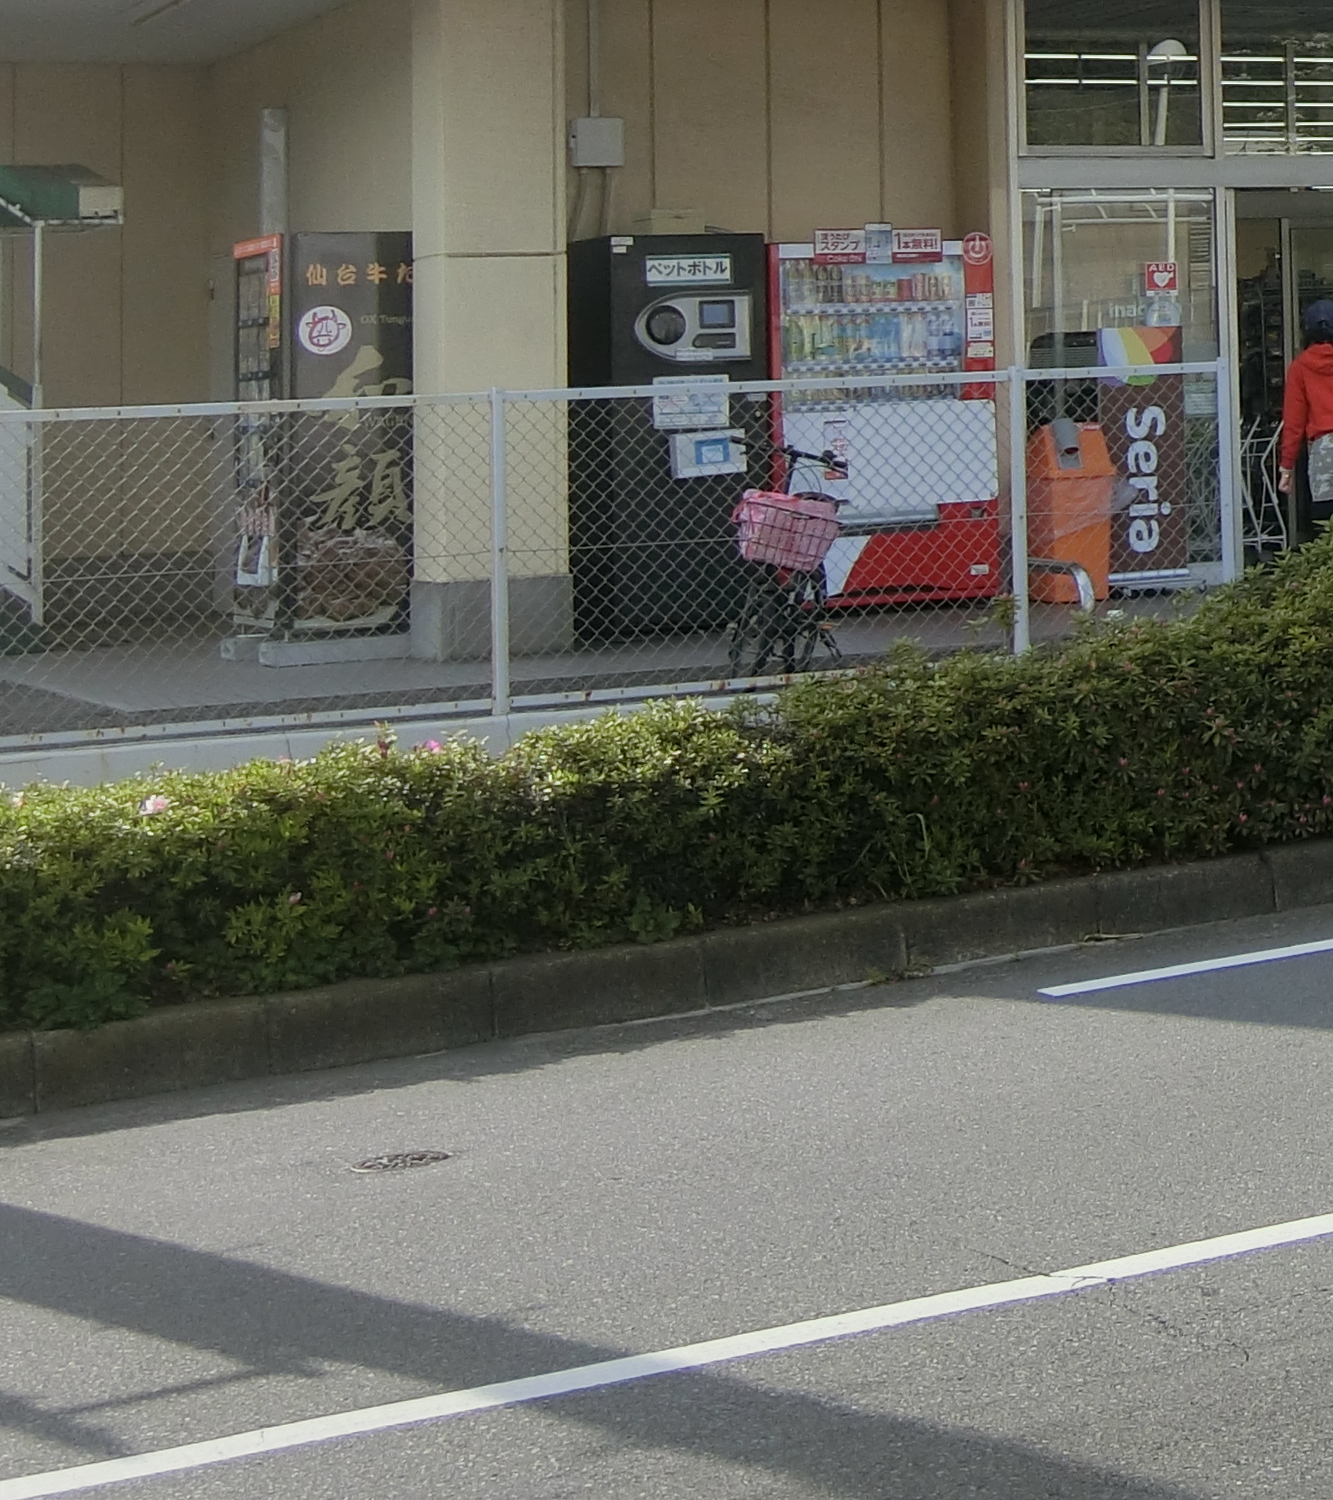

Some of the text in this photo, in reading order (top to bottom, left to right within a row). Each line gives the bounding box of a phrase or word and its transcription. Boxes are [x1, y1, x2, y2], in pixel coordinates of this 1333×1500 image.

[820, 240, 861, 252] スタンプ
[647, 260, 728, 277] ペットボトル
[1148, 263, 1175, 272] AED
[1126, 404, 1172, 553] Seria
